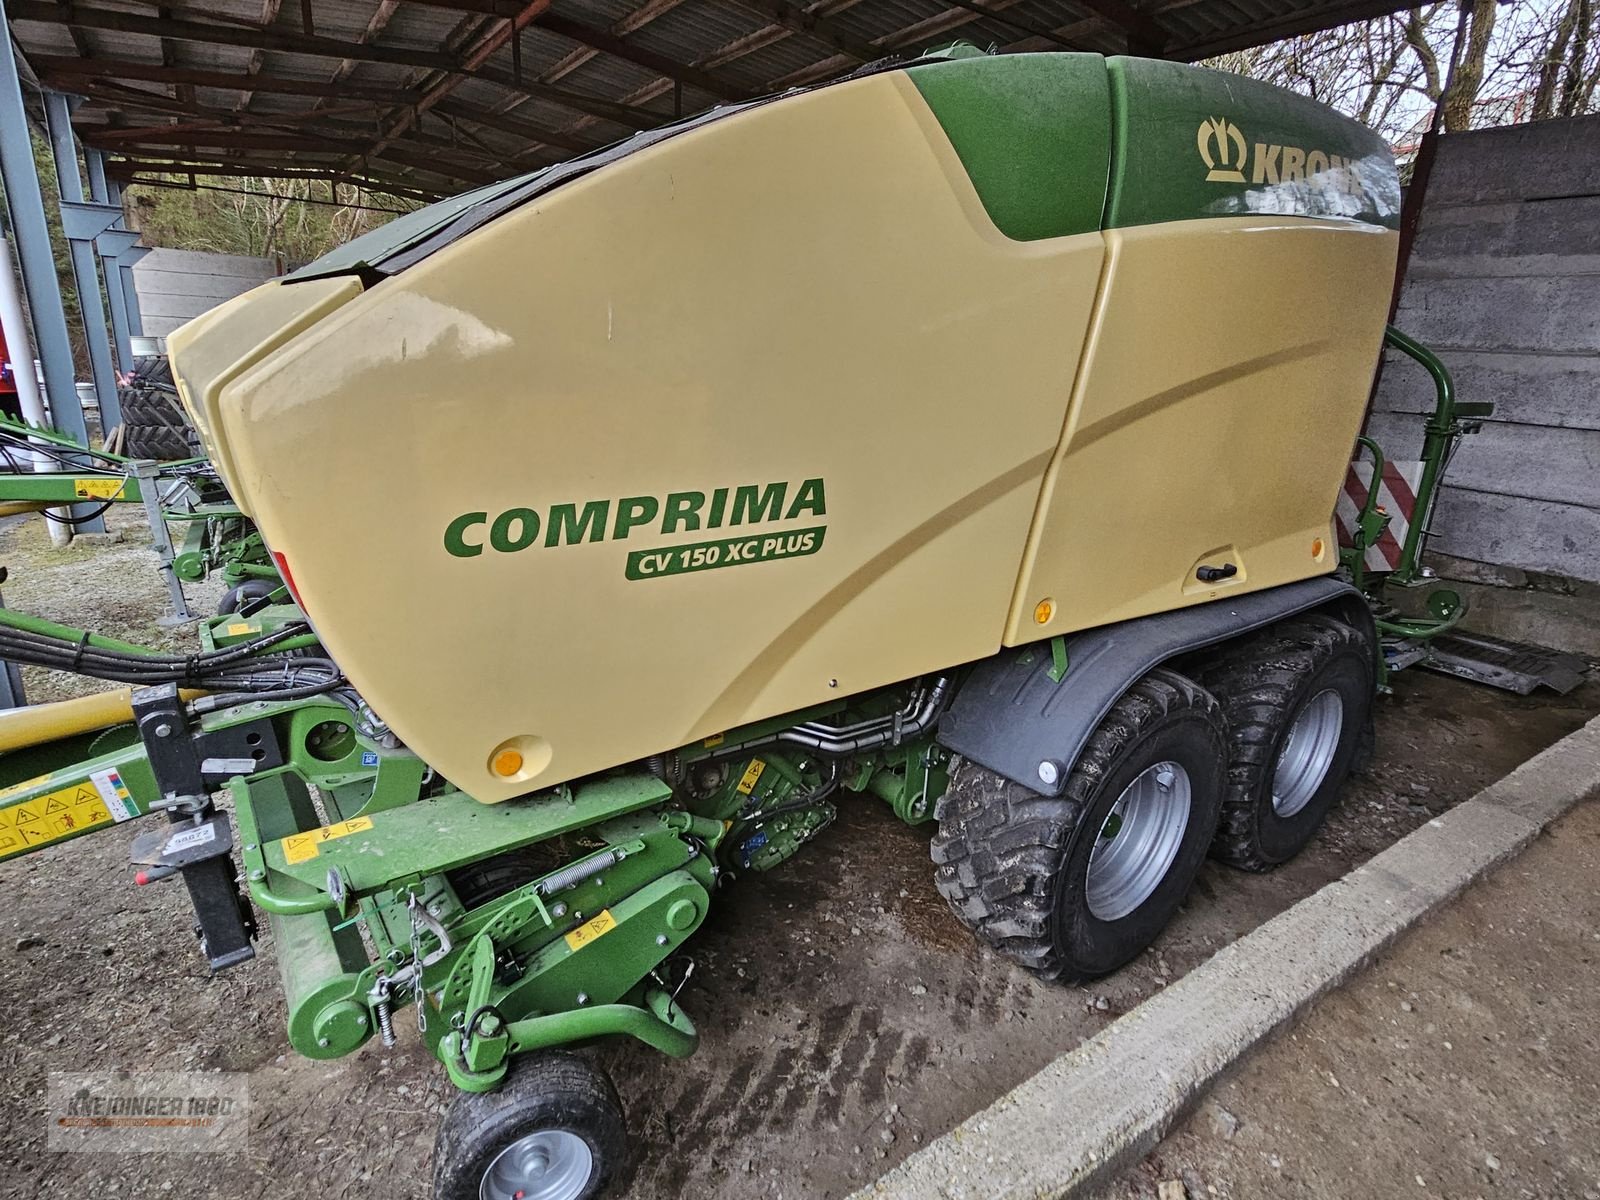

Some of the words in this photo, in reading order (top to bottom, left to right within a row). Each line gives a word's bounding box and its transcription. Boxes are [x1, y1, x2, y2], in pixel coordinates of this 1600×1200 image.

[444, 478, 826, 557] COMPRIMA
[638, 553, 673, 574] CV
[680, 547, 720, 568] 150
[725, 541, 759, 562] XC
[761, 533, 815, 556] PLUS
